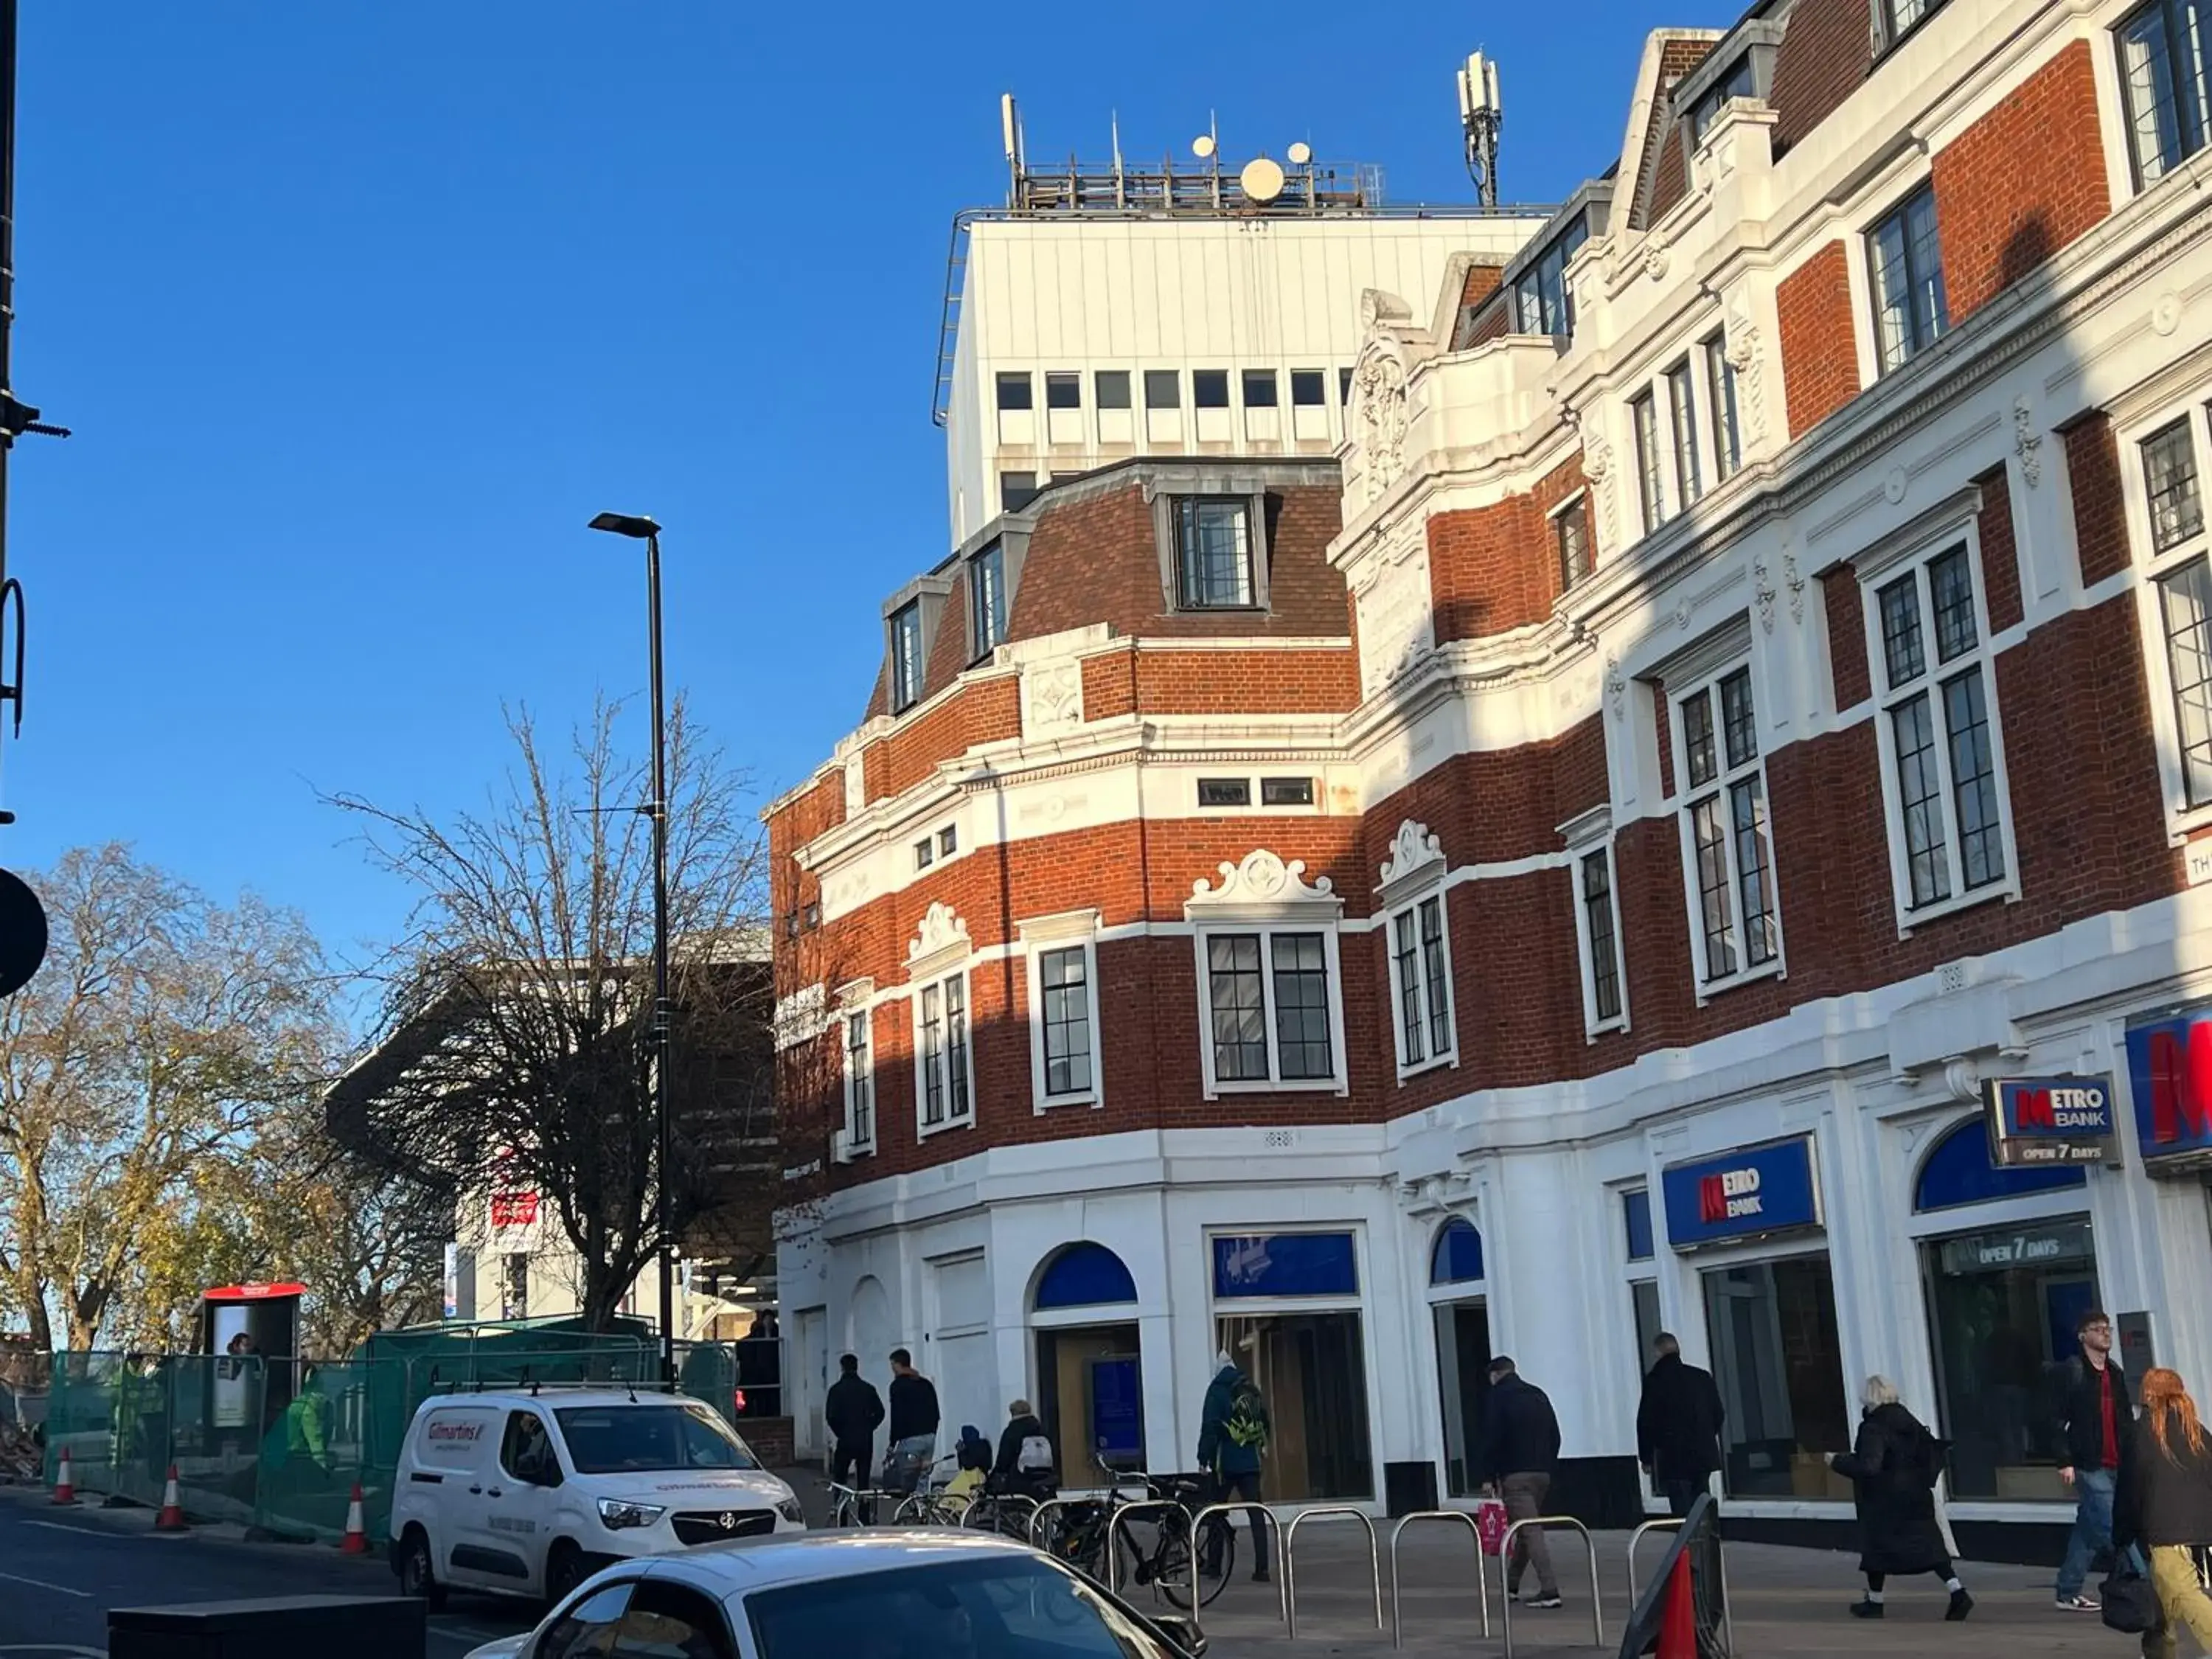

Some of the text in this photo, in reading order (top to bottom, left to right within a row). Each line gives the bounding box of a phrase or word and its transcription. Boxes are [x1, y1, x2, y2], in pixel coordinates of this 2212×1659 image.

[2191, 853, 2212, 874] TH
[2017, 1088, 2104, 1128] METRO
[2055, 1112, 2106, 1127] BANK
[2023, 1144, 2101, 1160] OPEN 7 DAYS
[1726, 1196, 1763, 1217] BANK
[1979, 1237, 2059, 1264] OPEN 7 DAYS
